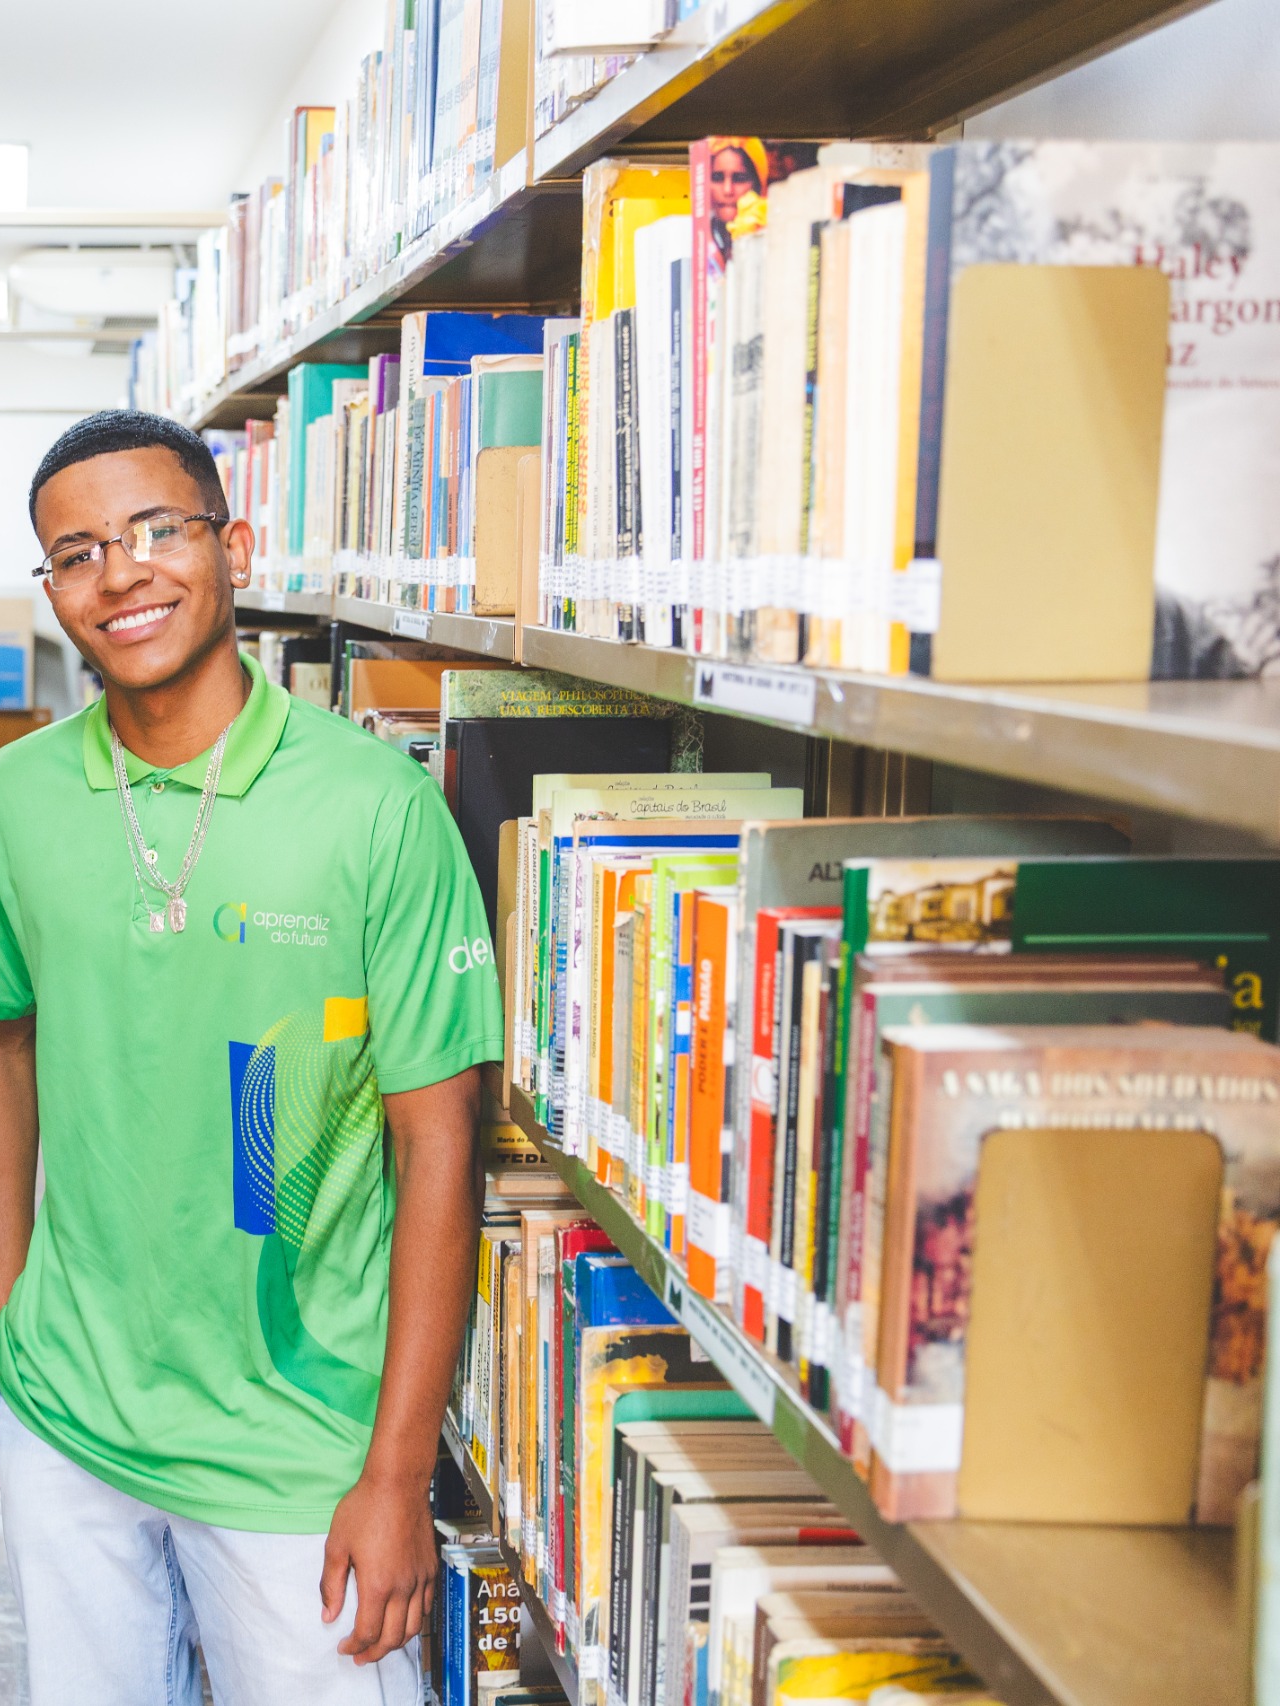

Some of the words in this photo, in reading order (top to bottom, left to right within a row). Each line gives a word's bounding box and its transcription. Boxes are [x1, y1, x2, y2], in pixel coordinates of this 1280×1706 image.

[500, 690, 553, 702] VIAGEM
[499, 704, 532, 716] UMA
[536, 704, 630, 717] REDESCOBERTA
[629, 799, 674, 816] Capitais
[676, 800, 690, 813] do
[691, 799, 727, 813] Brasil
[253, 911, 331, 931] aprendiz
[697, 958, 713, 1022] PAIXÃO
[477, 1580, 520, 1599] Aná
[478, 1606, 520, 1624] 150
[478, 1633, 508, 1651] de
